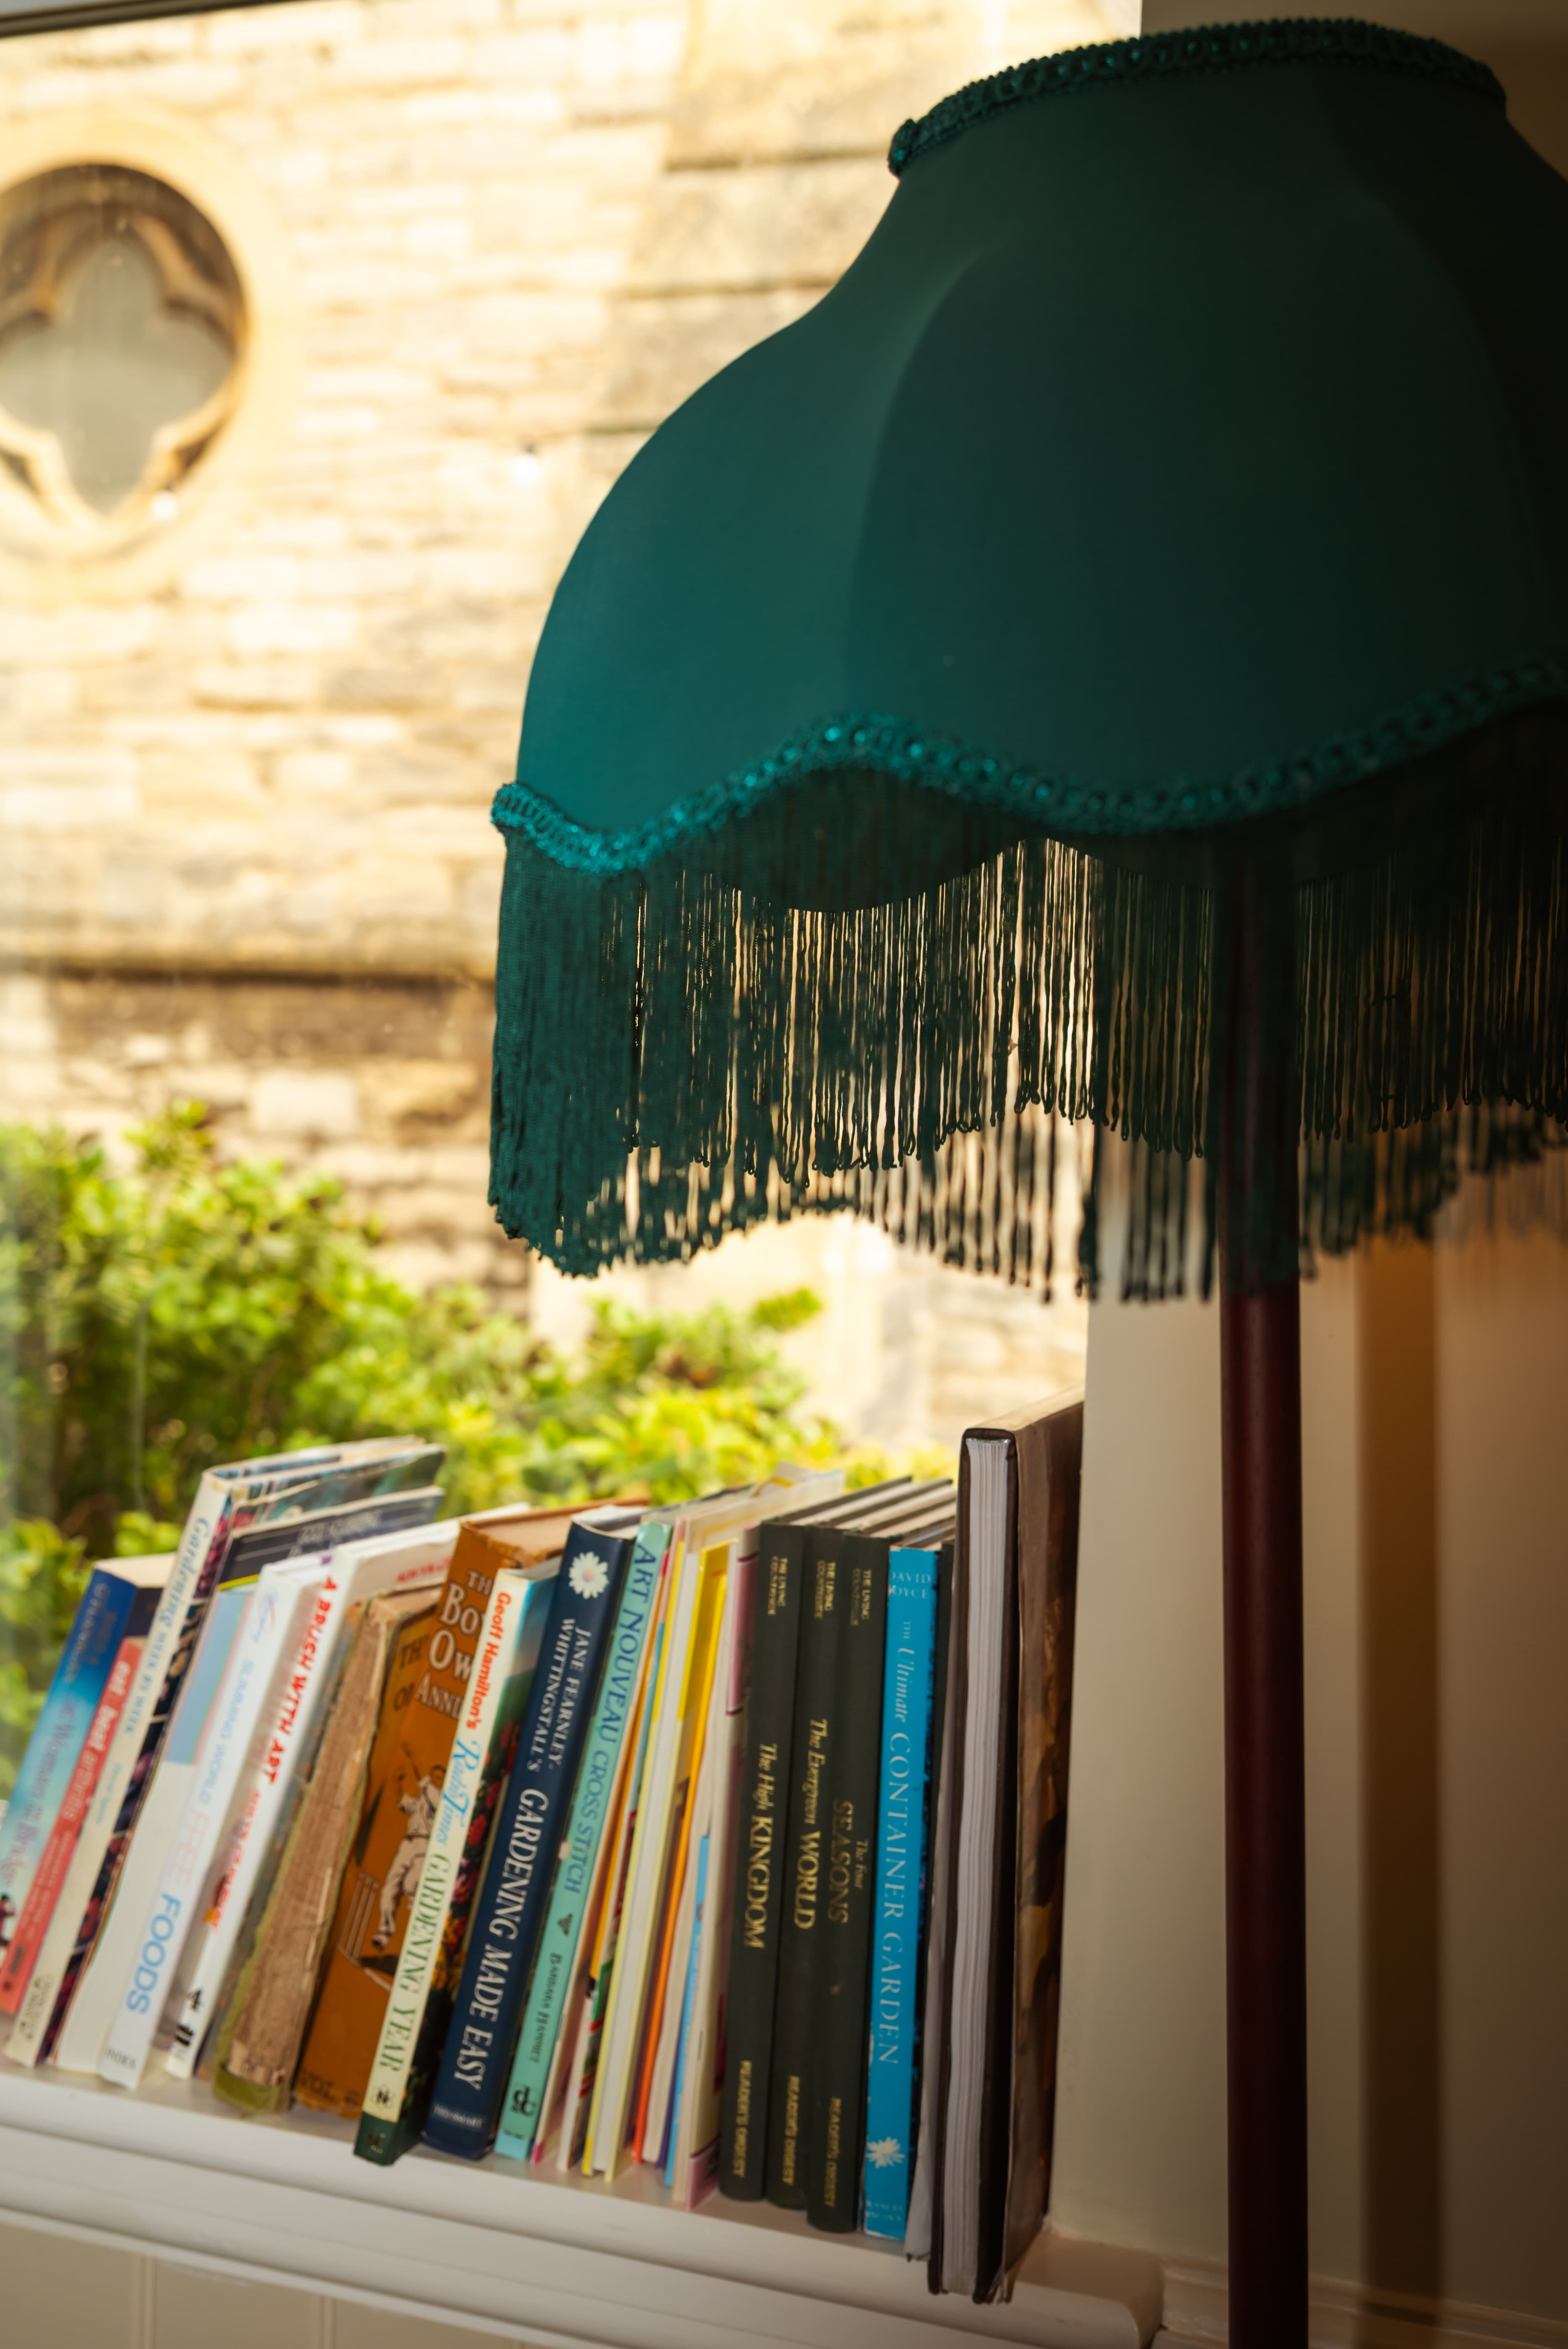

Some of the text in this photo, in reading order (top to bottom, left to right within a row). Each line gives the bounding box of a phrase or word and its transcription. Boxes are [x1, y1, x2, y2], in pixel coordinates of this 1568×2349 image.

[159, 1518, 210, 1627] Gardening
[439, 1581, 487, 1639] BO
[466, 1570, 494, 1597] TH
[889, 1586, 928, 1599] OYCE
[147, 1631, 166, 1669] WEEK
[262, 1577, 340, 1784] A BRUSH WITH ART
[429, 1629, 473, 1683] OW
[466, 1592, 511, 1731] Geoff Hamilton's
[527, 1618, 576, 1772] WHITTINGSTALL'S
[548, 1627, 591, 1770] JANE FEARNLEY-
[895, 1647, 915, 1723] Ultimate
[126, 1696, 145, 1736] WEEK
[564, 1544, 656, 1894] ART NOUVEAU CROSS STITCH
[199, 1745, 227, 1805] WORLD
[794, 1718, 828, 1930] The Evergreen WORLD
[884, 1732, 910, 1918] CONTAINER
[173, 1810, 209, 1887] FREE
[744, 1743, 778, 1949] The High KINGDOM
[828, 1799, 854, 1924] SEASONS
[855, 1839, 869, 1862] The
[126, 1893, 182, 2016] FOODS
[399, 1853, 451, 1994] GARDENING
[454, 1789, 550, 2091] GARDENING MADE EASY
[543, 1953, 563, 2009] BARBARA
[379, 2005, 417, 2072] YEAR
[879, 1932, 902, 2064] GARDEN
